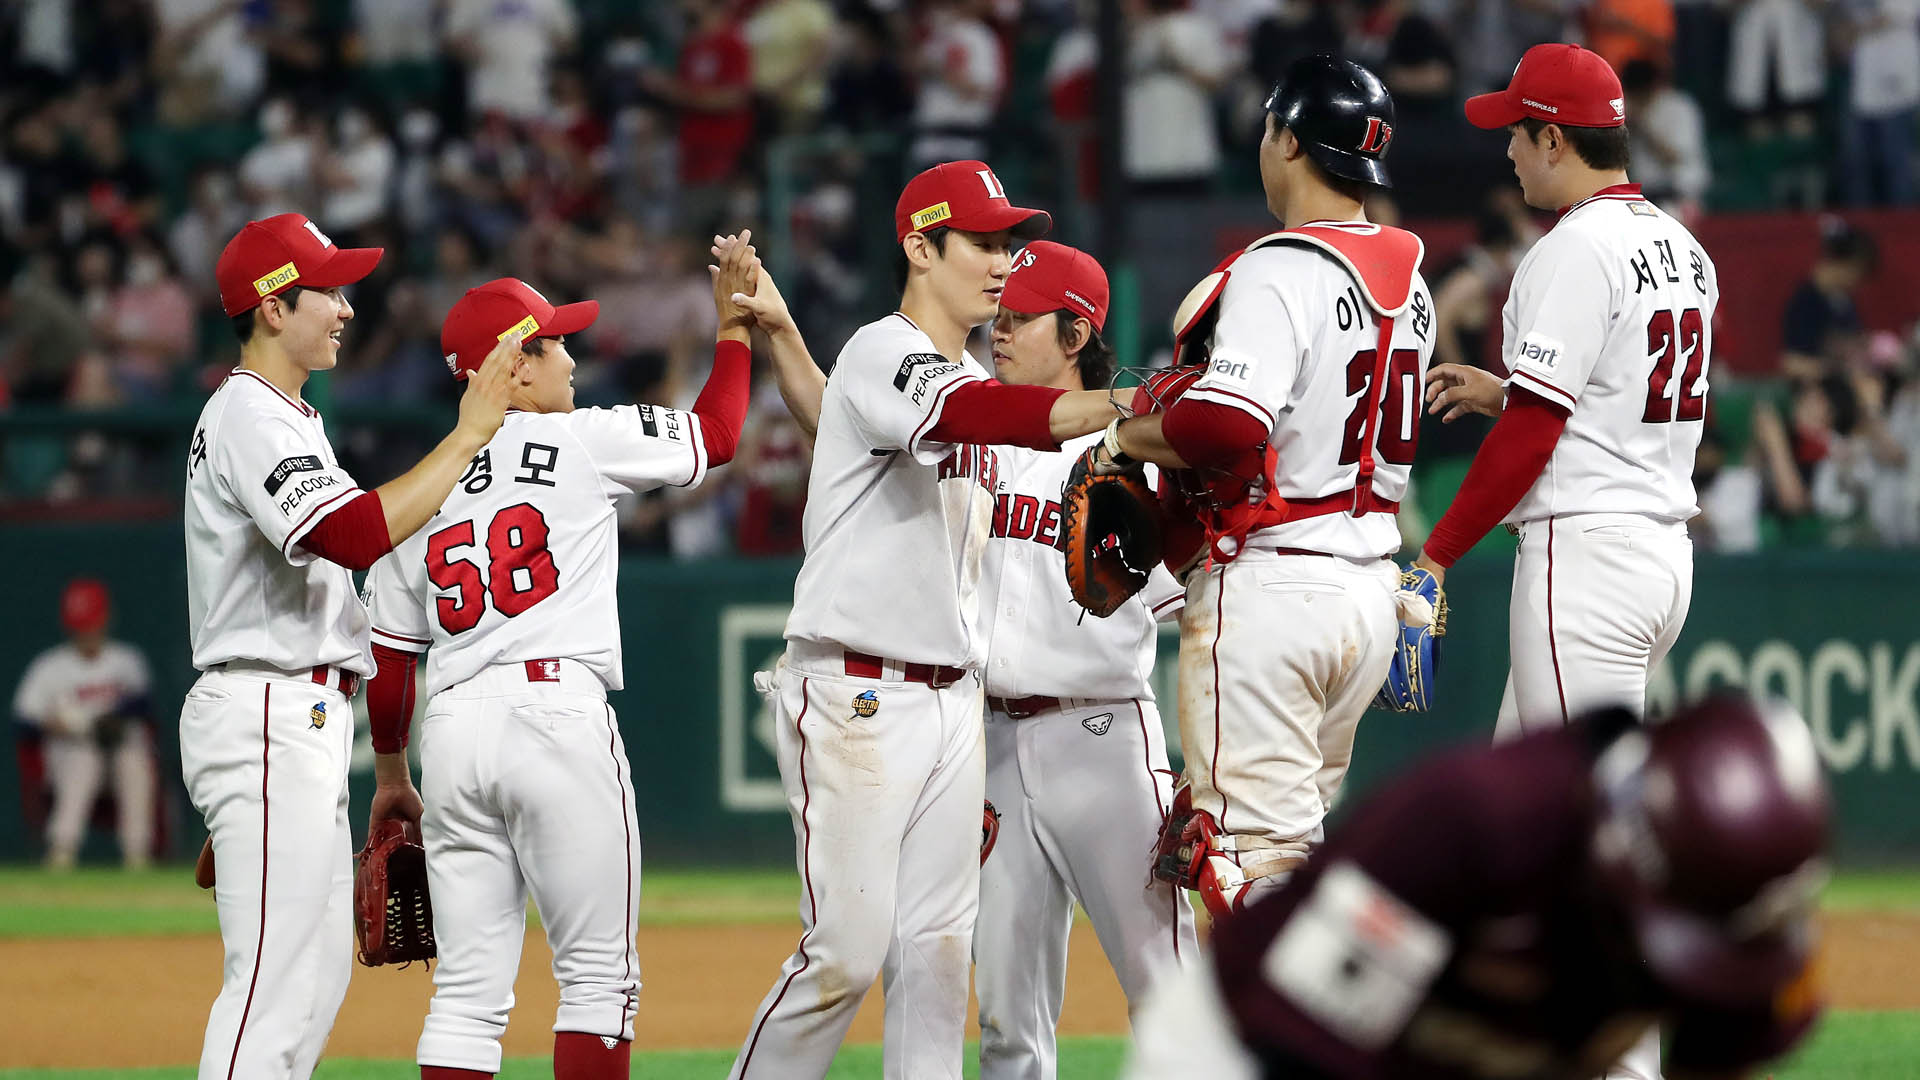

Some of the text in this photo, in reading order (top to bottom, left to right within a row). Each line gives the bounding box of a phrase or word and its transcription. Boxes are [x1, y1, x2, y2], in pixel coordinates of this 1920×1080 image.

[914, 206, 947, 227] emart
[258, 267, 295, 292] emart
[1630, 239, 1706, 295] 서진용
[911, 364, 964, 407] PEACOCK
[1641, 308, 1704, 423] 22
[1338, 348, 1421, 466] 20
[281, 475, 340, 516] PEACOCK
[424, 502, 560, 636] 58
